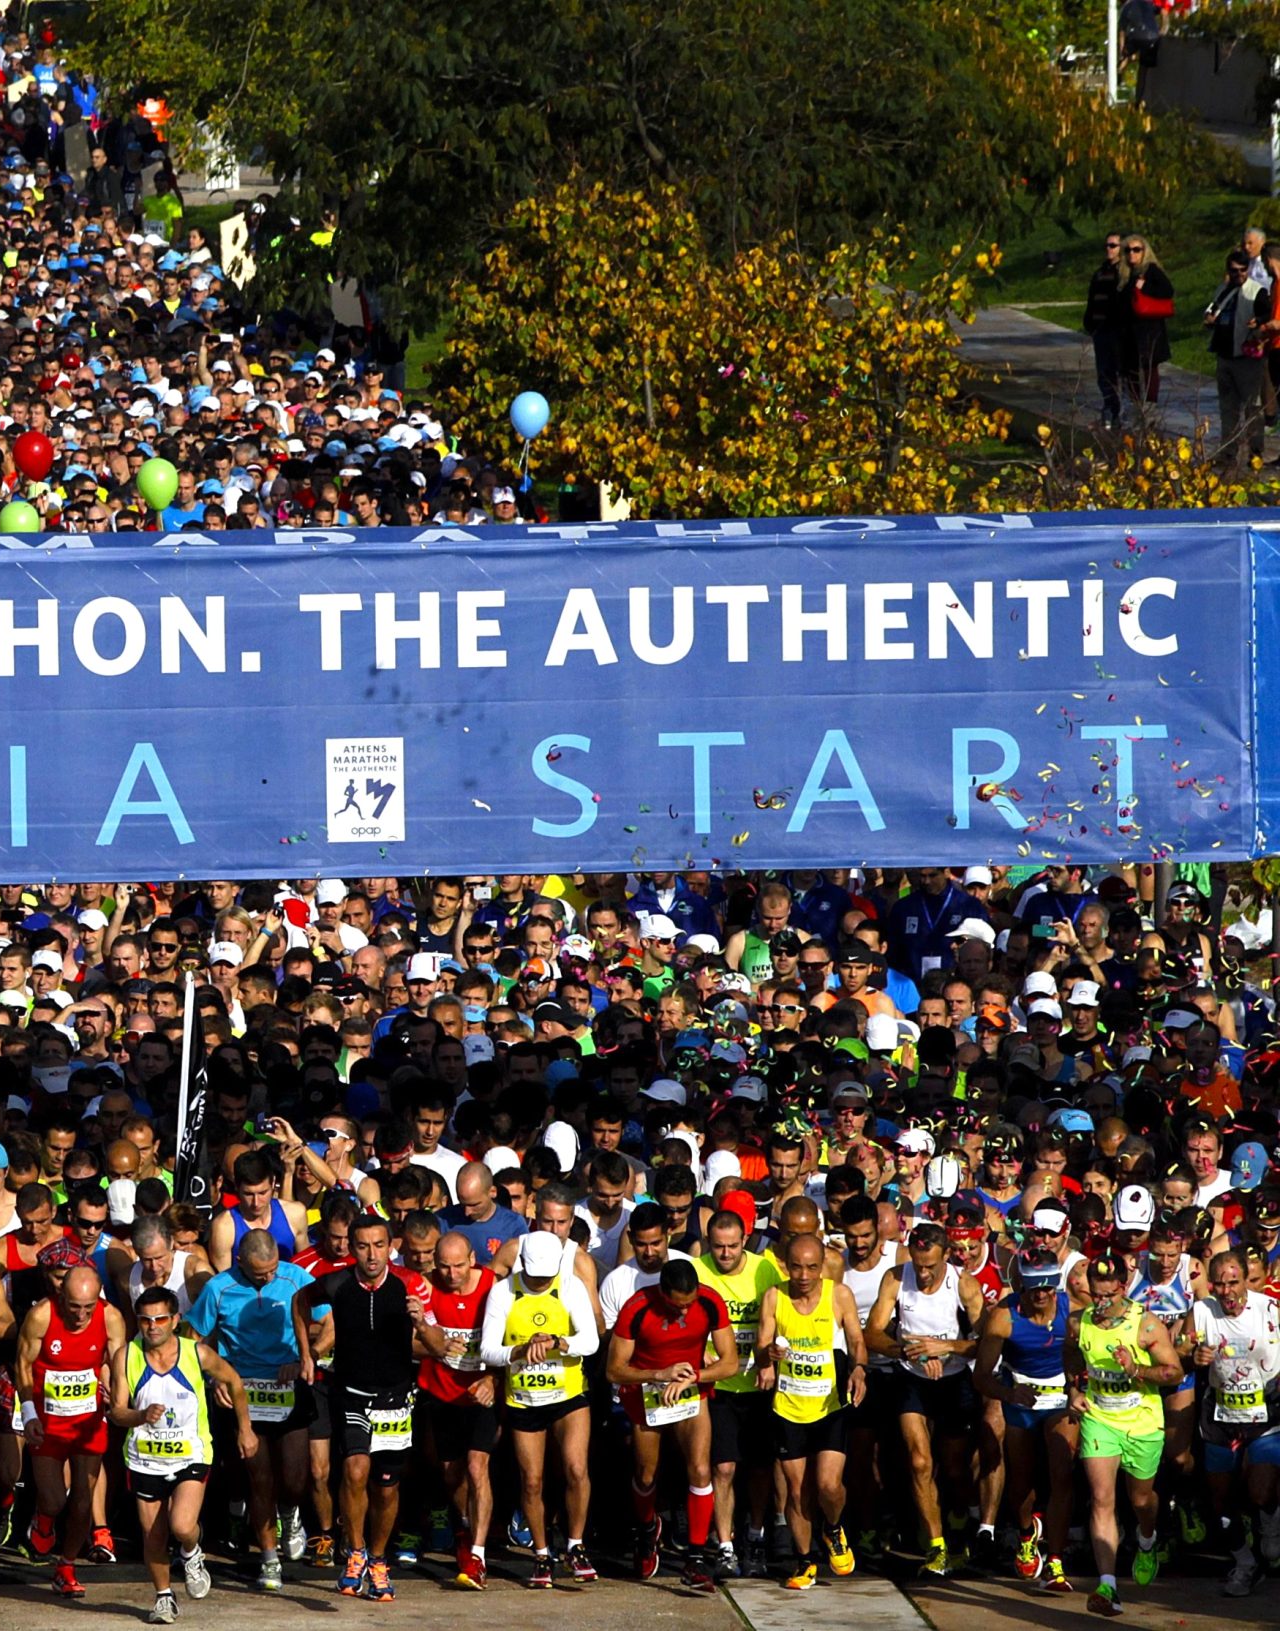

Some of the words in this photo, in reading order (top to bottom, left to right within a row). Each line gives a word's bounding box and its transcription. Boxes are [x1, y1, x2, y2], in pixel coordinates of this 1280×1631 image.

[299, 590, 507, 671] THE
[544, 577, 1178, 666] AUTHENTIC
[343, 745, 387, 753] ATHENS
[333, 755, 397, 764] MARATHON
[531, 723, 1169, 838] START
[351, 826, 381, 837] opap
[787, 1363, 823, 1378] 1594
[518, 1374, 557, 1387] 1294
[54, 1384, 90, 1398] 1285
[248, 1391, 285, 1404] 1861
[372, 1421, 408, 1433] 1912
[145, 1441, 184, 1454] 1752
